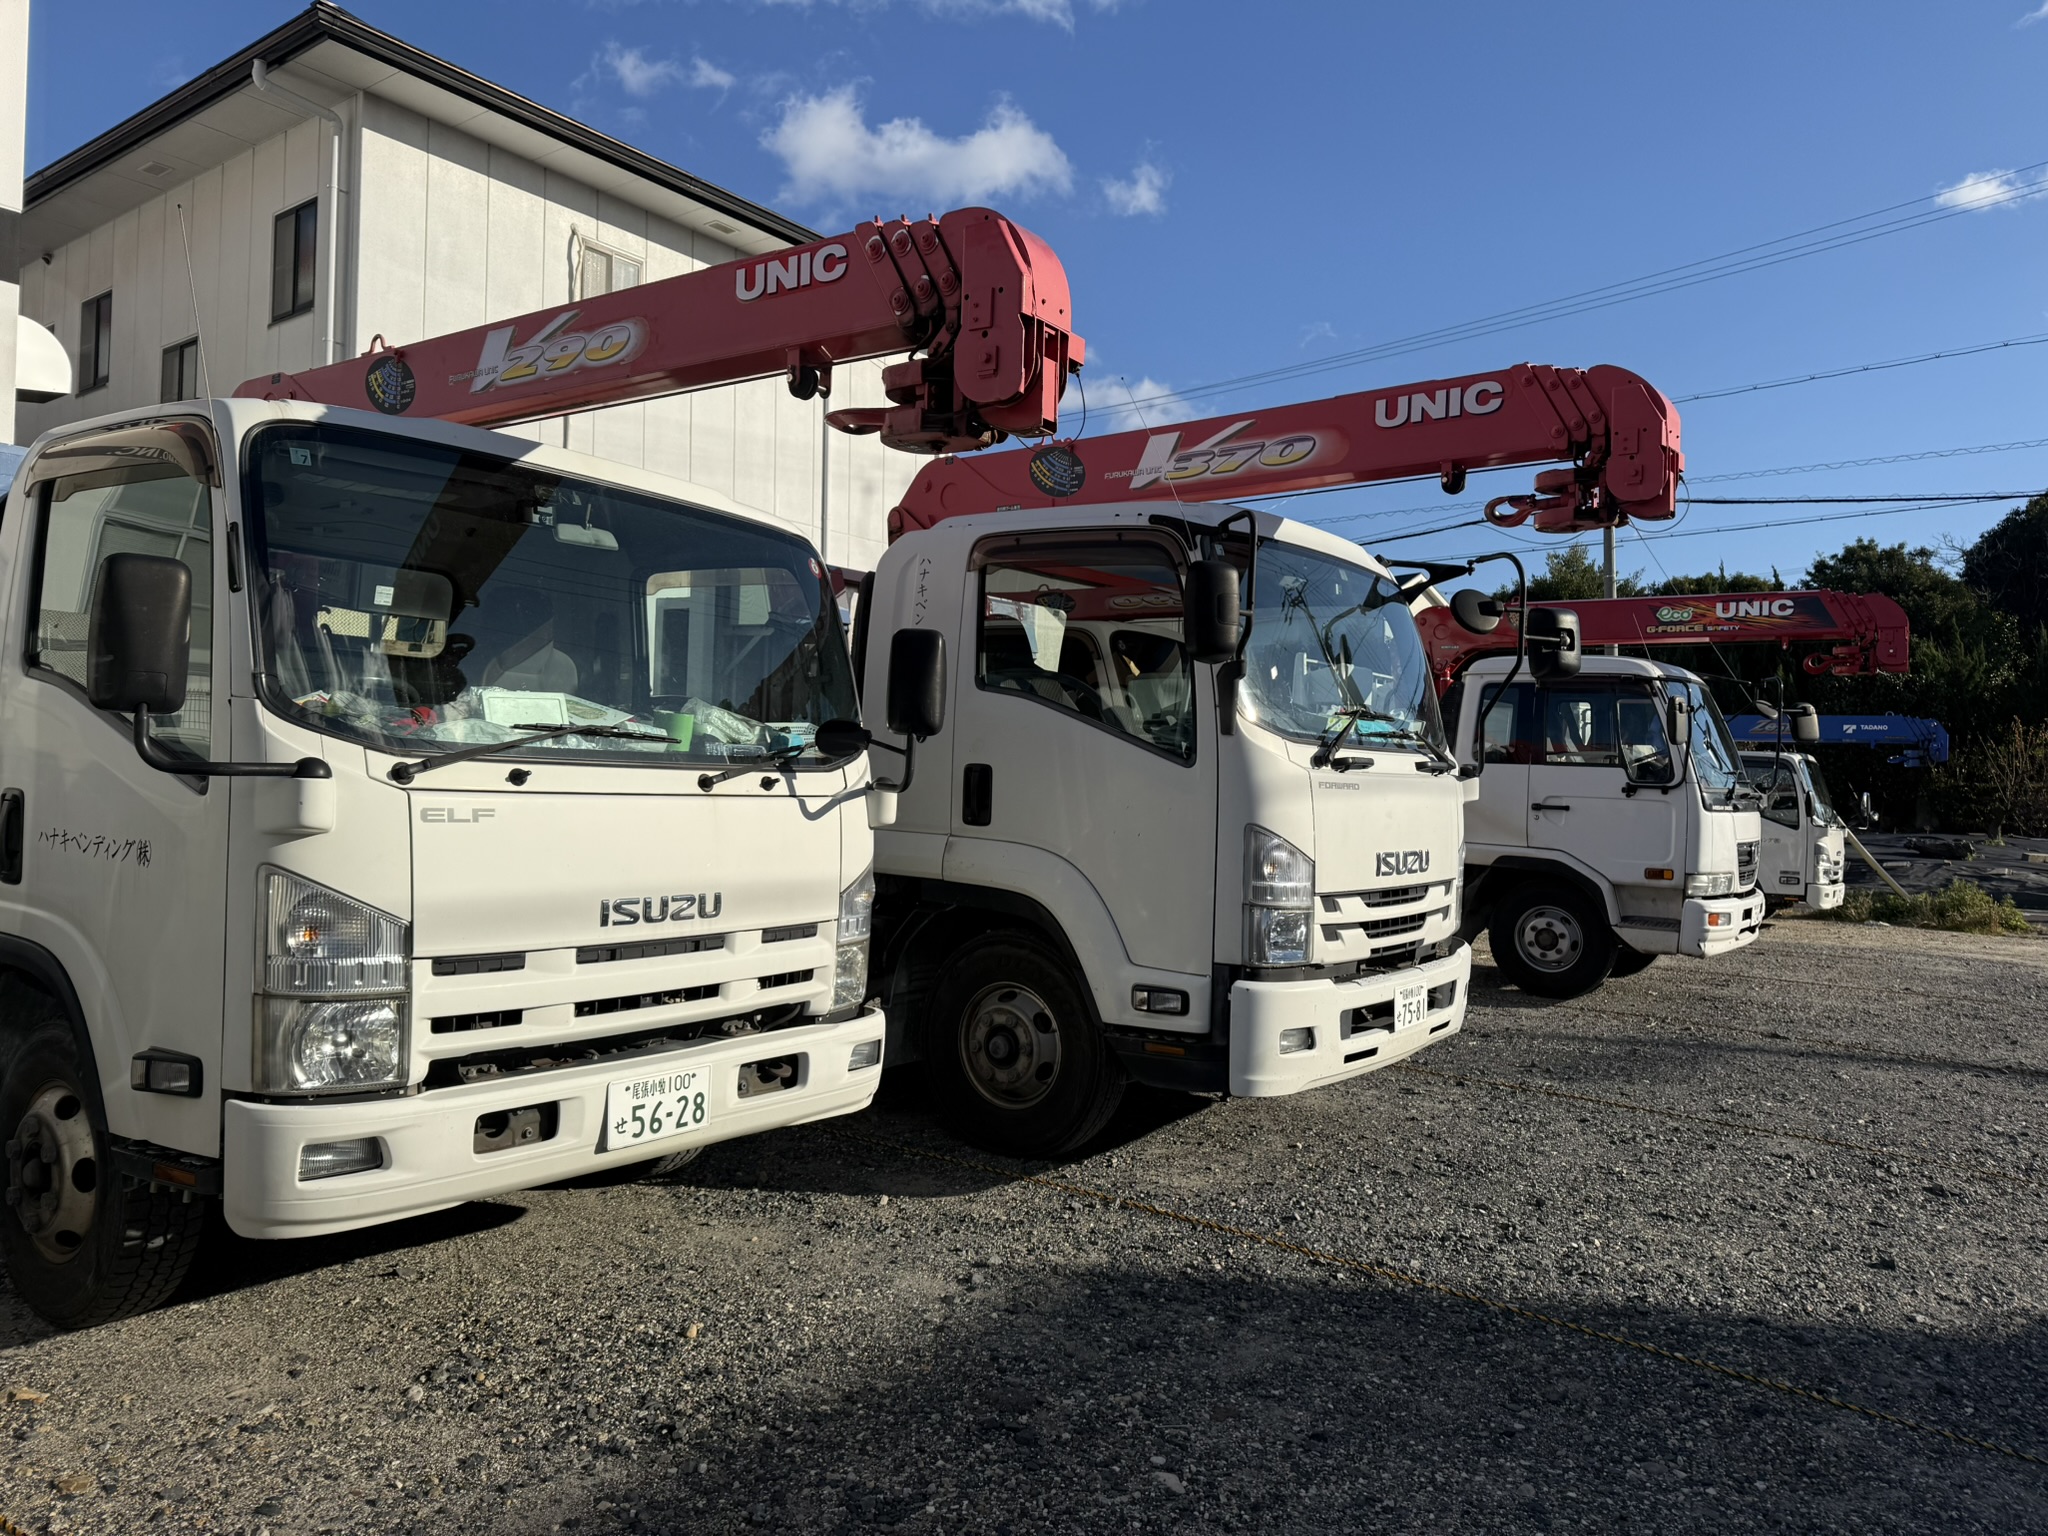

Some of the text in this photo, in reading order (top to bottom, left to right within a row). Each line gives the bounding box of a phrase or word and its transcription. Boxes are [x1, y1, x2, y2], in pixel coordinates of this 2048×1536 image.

[735, 243, 849, 302] UNIC
[1374, 380, 1504, 429] UNIC
[1104, 468, 1145, 480] FURUKAWA
[1656, 606, 1694, 622] eco
[1715, 599, 1795, 619] UNIC
[1318, 781, 1360, 791] FORWARD
[420, 807, 496, 823] ELF
[1375, 849, 1430, 877] ISUZU
[600, 892, 722, 927] ISUZU
[668, 1073, 692, 1094] 100
[614, 1091, 706, 1139] せ 56-28
